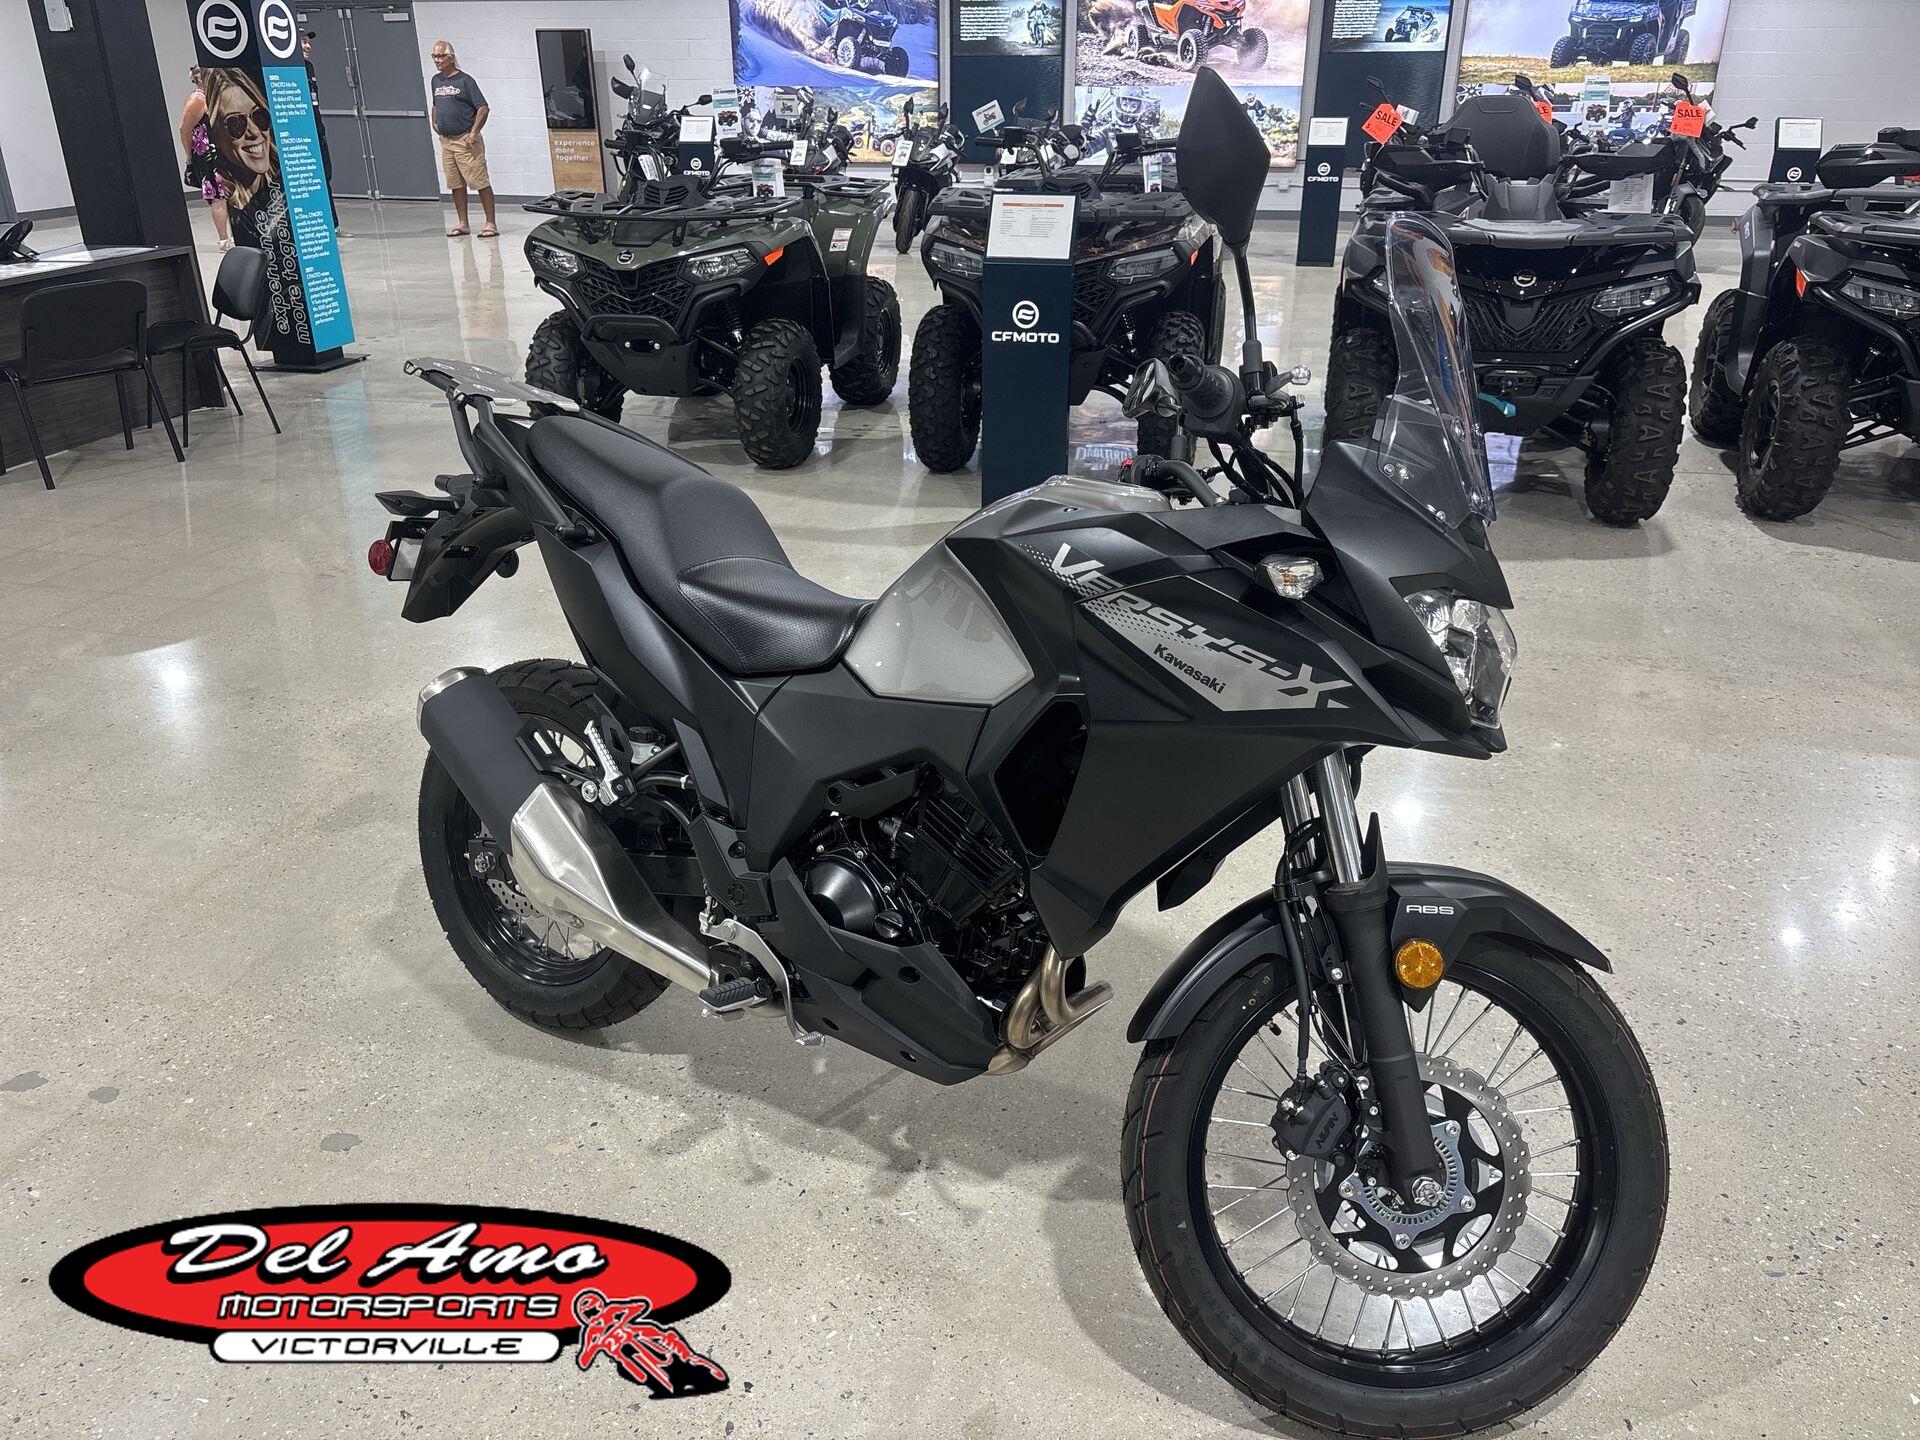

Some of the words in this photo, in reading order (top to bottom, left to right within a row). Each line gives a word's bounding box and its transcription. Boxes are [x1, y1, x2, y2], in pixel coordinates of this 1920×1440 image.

[1376, 110, 1398, 127] SALE
[1678, 109, 1702, 118] SALE
[556, 154, 590, 163] together
[268, 180, 298, 281] together
[255, 209, 290, 335] experience
[288, 285, 310, 345] more
[991, 331, 1060, 344] CFMOTO
[1050, 542, 1353, 708] VERSYS-X
[1152, 643, 1226, 695] Kawasaki
[1406, 904, 1454, 915] ABS
